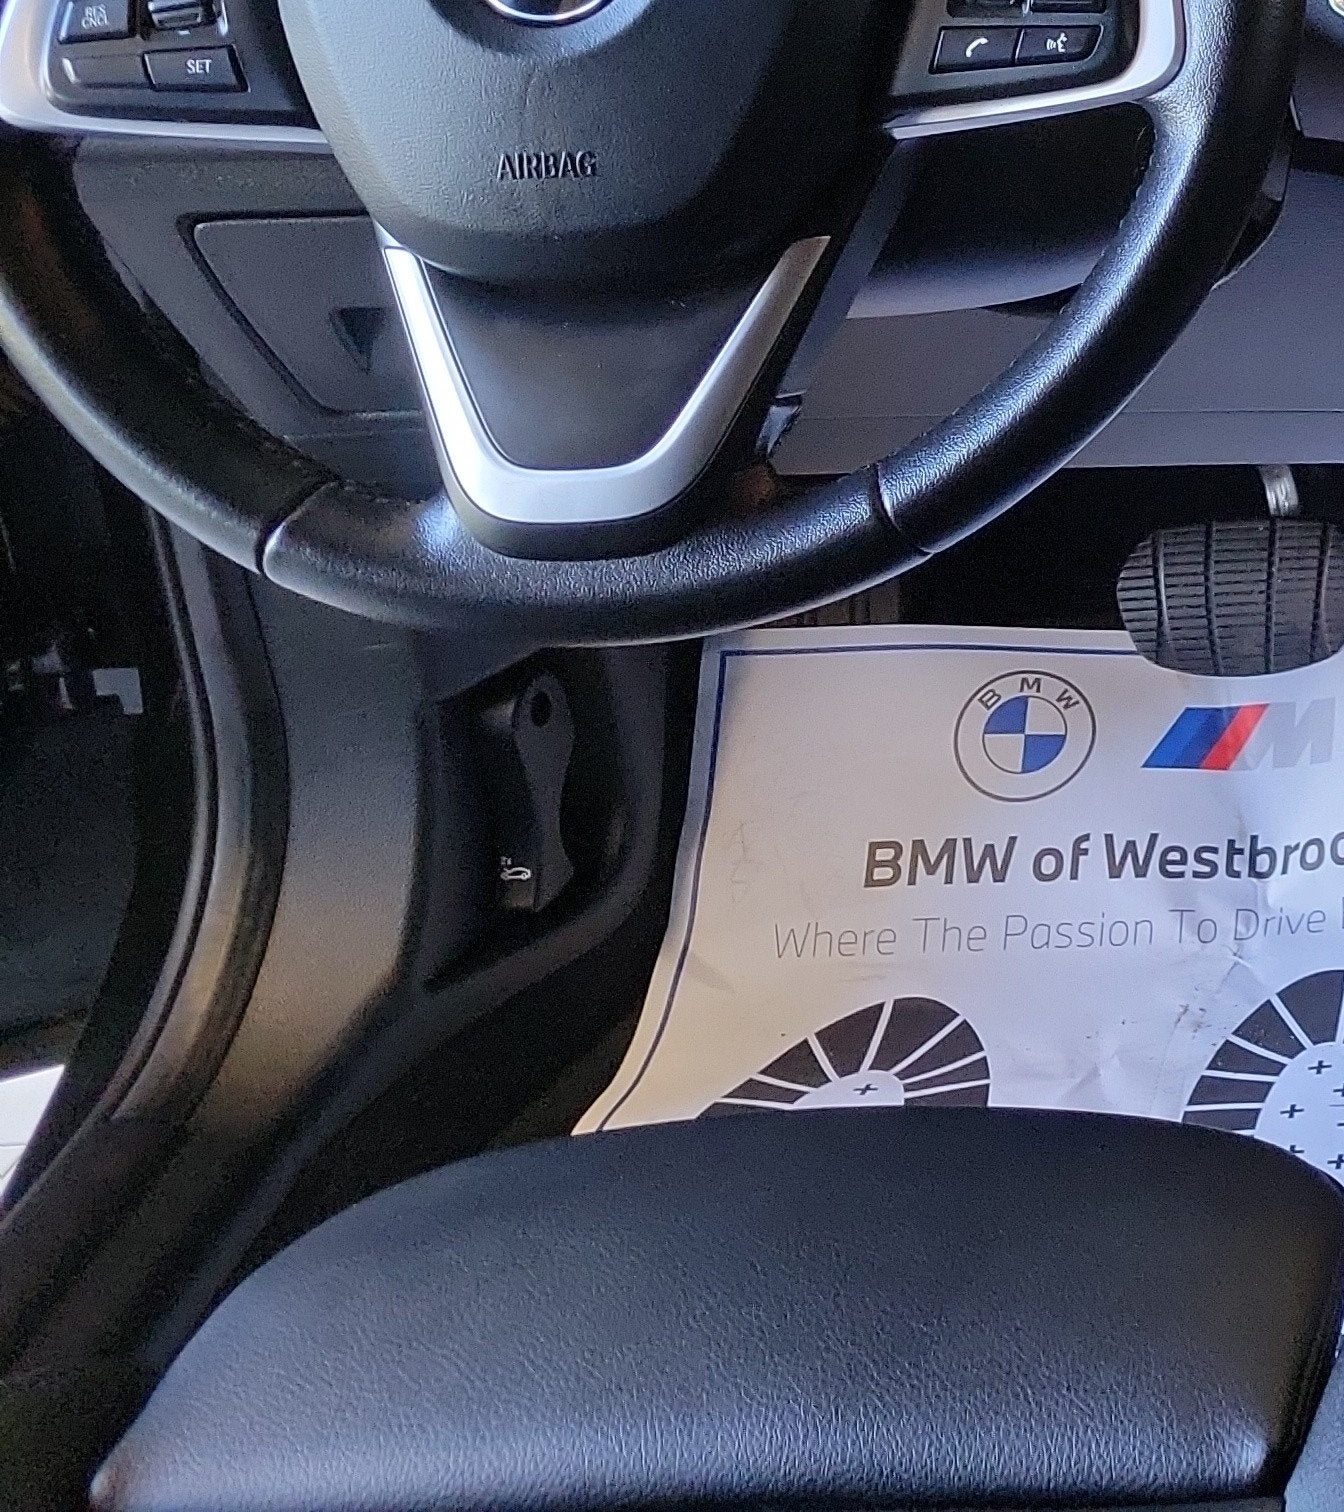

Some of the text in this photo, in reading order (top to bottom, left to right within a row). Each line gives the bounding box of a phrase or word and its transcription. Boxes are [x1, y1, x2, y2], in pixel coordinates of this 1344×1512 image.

[186, 59, 212, 75] SET
[496, 150, 598, 180] AIRBAG
[977, 676, 1081, 712] BMW
[1230, 696, 1336, 772] M
[864, 835, 1018, 888] BMW
[1032, 832, 1091, 882] of
[775, 921, 898, 959] Where
[912, 916, 988, 954] The
[1002, 912, 1154, 951] Passion
[1168, 908, 1218, 944] To
[1233, 906, 1327, 941] Drive
